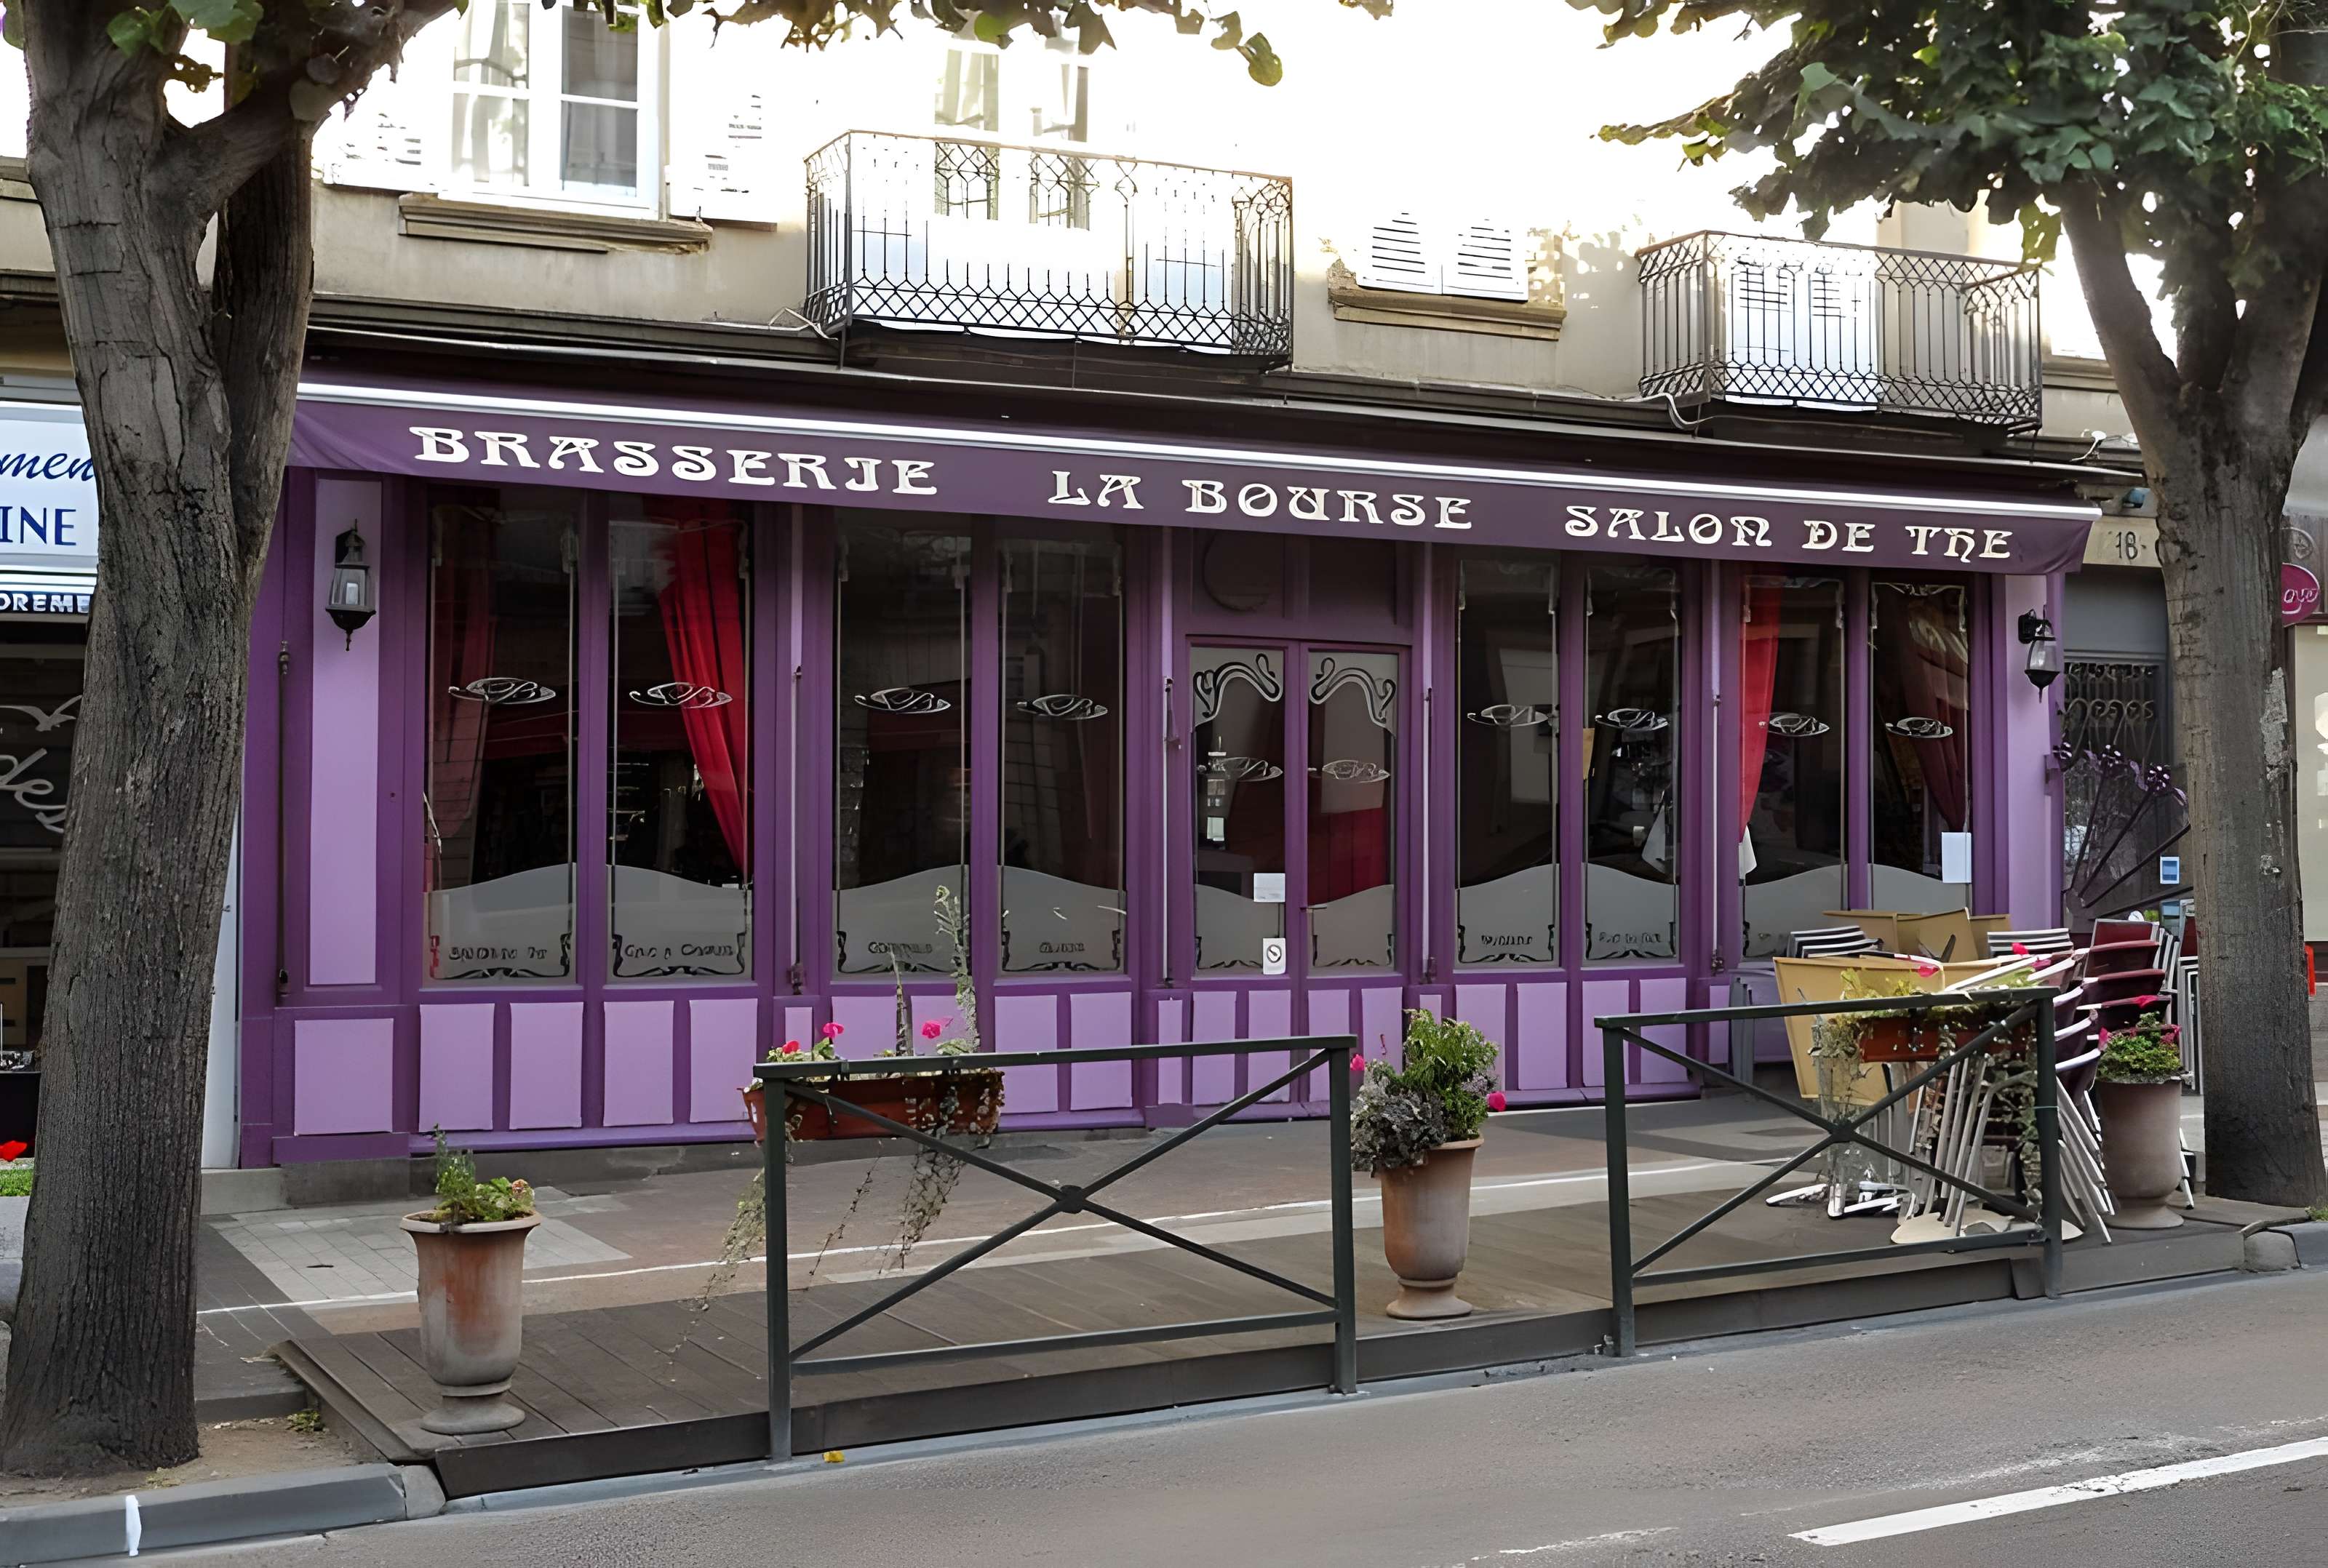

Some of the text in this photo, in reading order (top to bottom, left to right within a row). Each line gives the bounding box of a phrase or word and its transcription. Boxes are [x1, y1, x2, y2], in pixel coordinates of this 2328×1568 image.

[1048, 471, 1144, 510] LA
[1181, 479, 1472, 529] BOURSE
[1565, 505, 1772, 547] SALON
[1801, 520, 1875, 553] DE
[2116, 531, 2138, 560] 18
